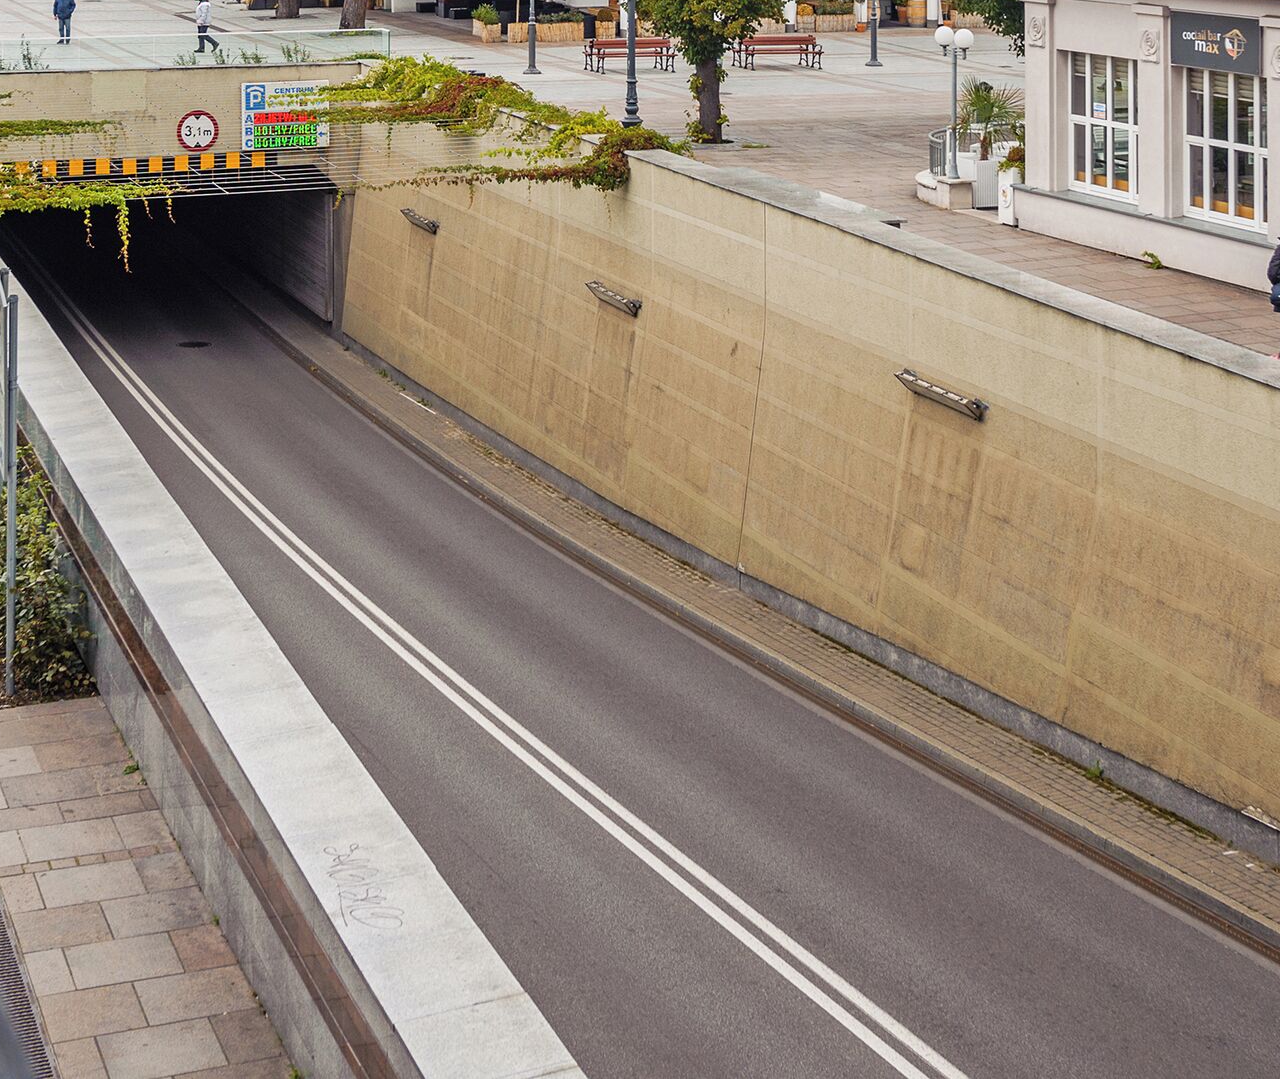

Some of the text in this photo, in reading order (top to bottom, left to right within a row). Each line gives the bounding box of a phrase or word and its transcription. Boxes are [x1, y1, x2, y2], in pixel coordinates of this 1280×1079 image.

[1207, 30, 1221, 41] bar
[1194, 40, 1220, 55] max
[274, 86, 314, 94] CENTRUM
[245, 127, 253, 136] B
[245, 139, 253, 148] C
